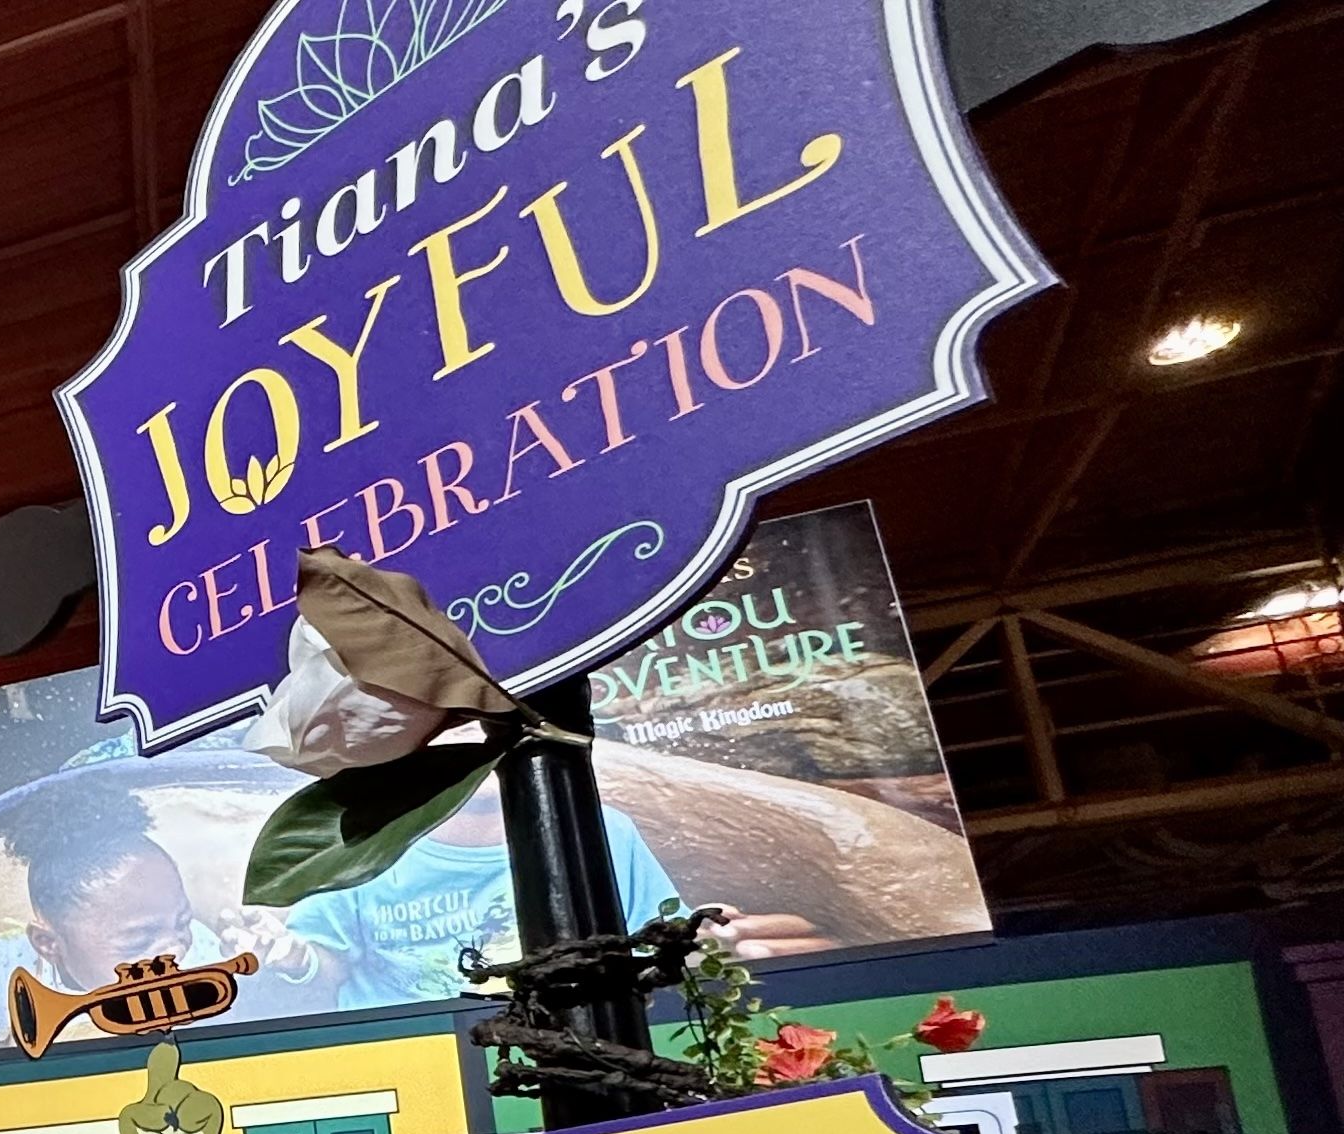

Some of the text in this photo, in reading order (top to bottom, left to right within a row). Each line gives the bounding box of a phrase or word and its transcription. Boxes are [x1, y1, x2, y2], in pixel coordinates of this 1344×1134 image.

[202, 0, 647, 329] Tiana's
[136, 47, 843, 547] JOYFUL
[158, 233, 875, 656] CELEBRATION
[587, 621, 865, 724] DVENTURE
[626, 700, 794, 745] Magic Kingdom
[410, 909, 480, 942] BAYOU
